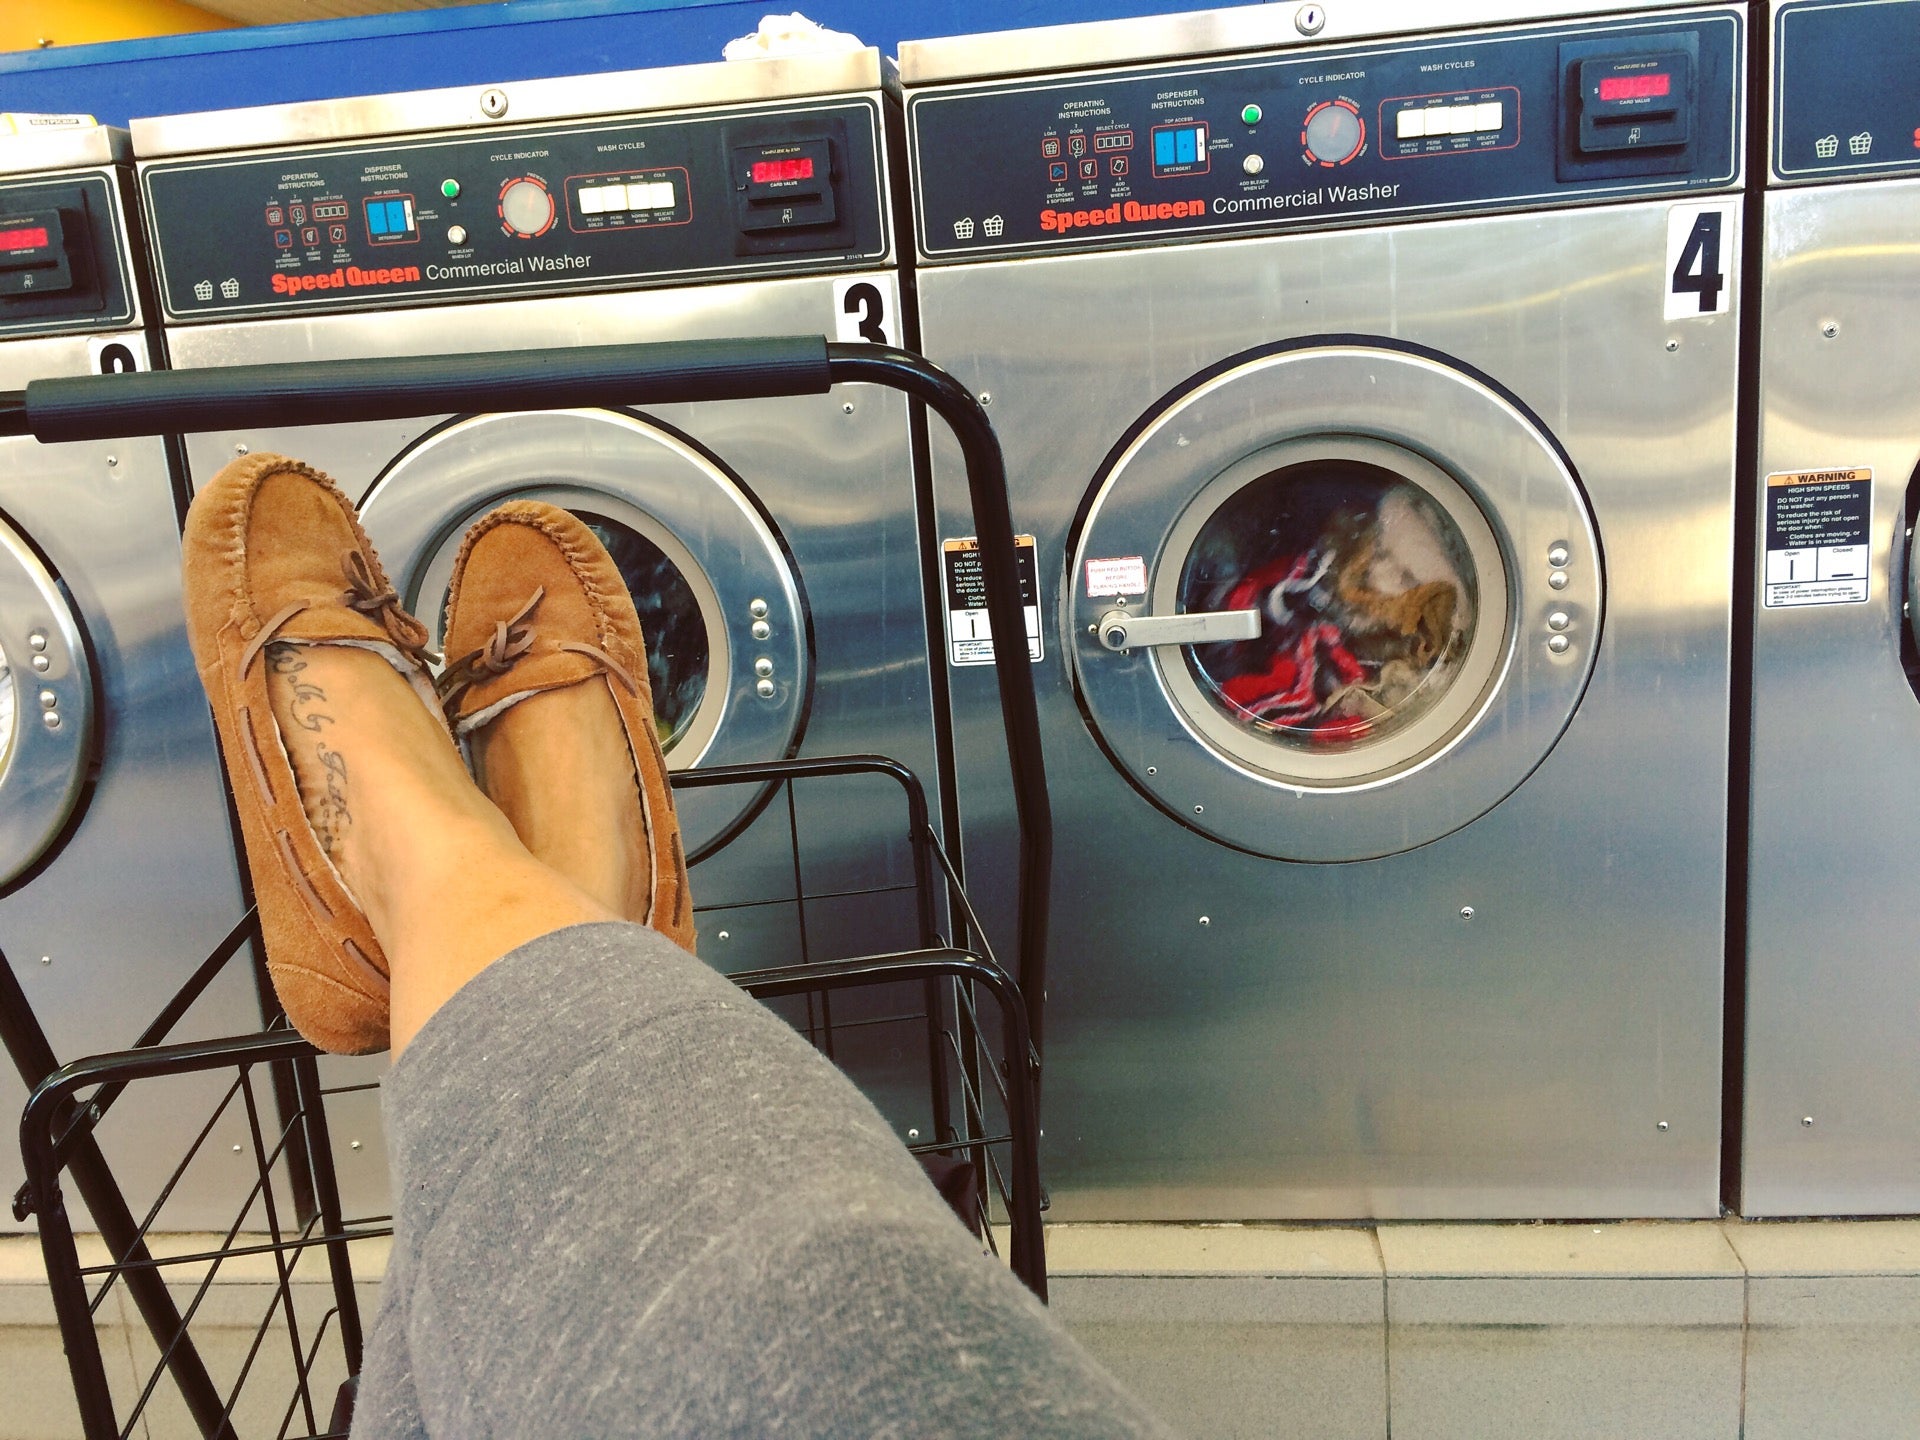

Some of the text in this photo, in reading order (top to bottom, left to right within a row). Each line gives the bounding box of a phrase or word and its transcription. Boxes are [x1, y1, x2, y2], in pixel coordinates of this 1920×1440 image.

[1420, 60, 1475, 72] WASH CYCLES
[1299, 72, 1365, 84] CYCLE INDICATOR
[1157, 90, 1198, 100] DISPENSER
[1064, 100, 1105, 109] OPERATING
[1152, 98, 1205, 109] INSTRUCTIONS
[1058, 108, 1111, 119] INSTRUCTIONS
[597, 142, 645, 152] WASH CYCLES
[490, 151, 549, 162] CYCLE INDICATOR
[365, 165, 401, 173] DISPENSER
[282, 172, 318, 181] OPERATING
[361, 172, 408, 182] INSTRUCTIONS
[278, 180, 325, 190] INSTRUCTIONS
[1040, 183, 1400, 234] Speed Queen Commercial Washer
[1672, 212, 1723, 312] 4
[272, 254, 592, 296] Speed Queen Commercial Washer
[844, 283, 887, 344] 3
[1798, 472, 1856, 483] WARNING
